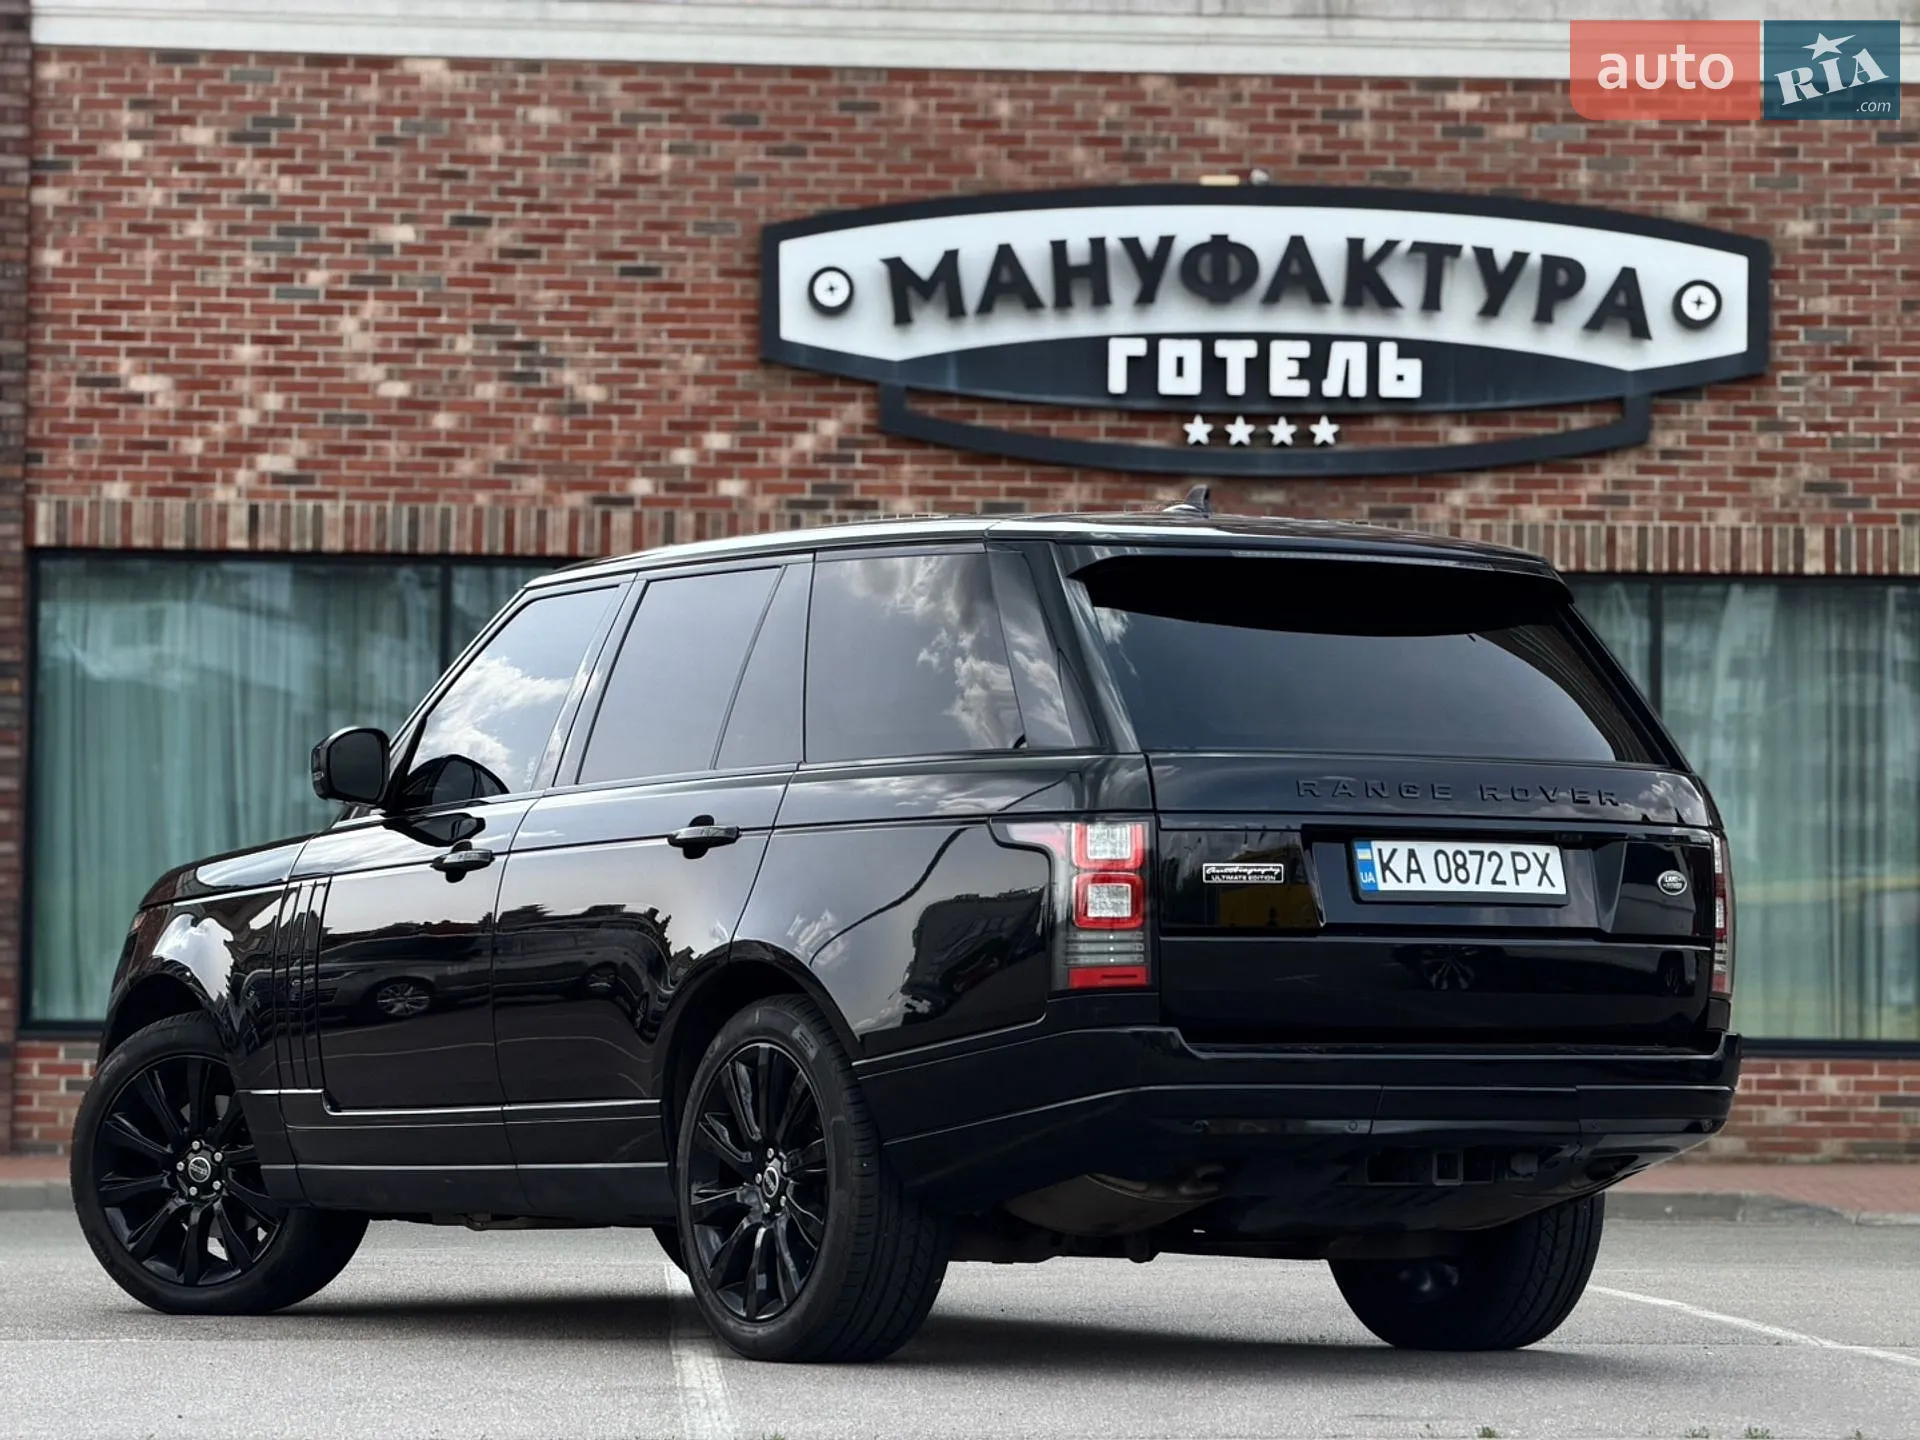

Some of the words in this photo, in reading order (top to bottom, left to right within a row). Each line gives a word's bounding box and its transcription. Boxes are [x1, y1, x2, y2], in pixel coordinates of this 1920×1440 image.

[880, 233, 1653, 341] МАНУФАКТУРА
[1107, 337, 1422, 399] ГОТЕЛЬ
[1296, 779, 1452, 800] RANGE
[1479, 783, 1621, 807] ROVER
[1359, 871, 1376, 884] UA
[1376, 847, 1428, 885] KA
[1433, 848, 1507, 886] 0872
[1510, 850, 1556, 888] PX
